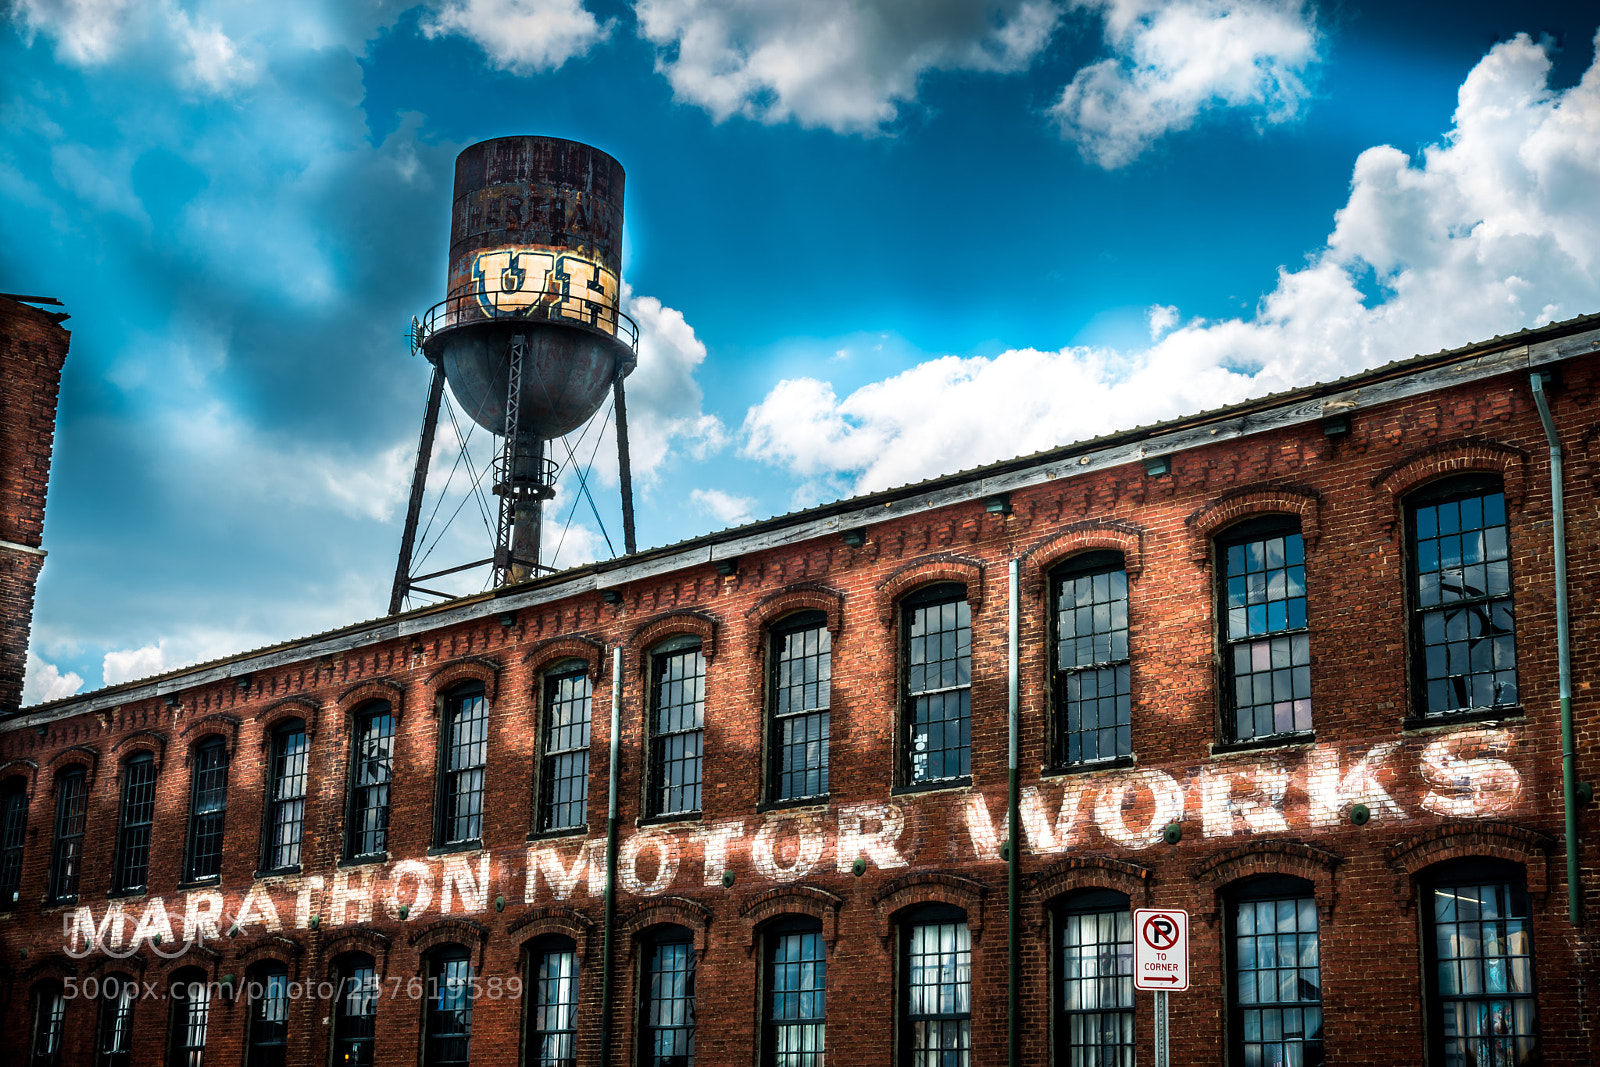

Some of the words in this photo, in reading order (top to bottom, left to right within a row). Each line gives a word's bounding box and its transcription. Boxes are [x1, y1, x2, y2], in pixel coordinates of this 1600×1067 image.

[71, 852, 491, 953] MARATHON
[524, 802, 909, 904] MOTOR
[964, 728, 1523, 860] WORKS
[1156, 953, 1167, 961] TO
[1144, 963, 1178, 971] CORNER
